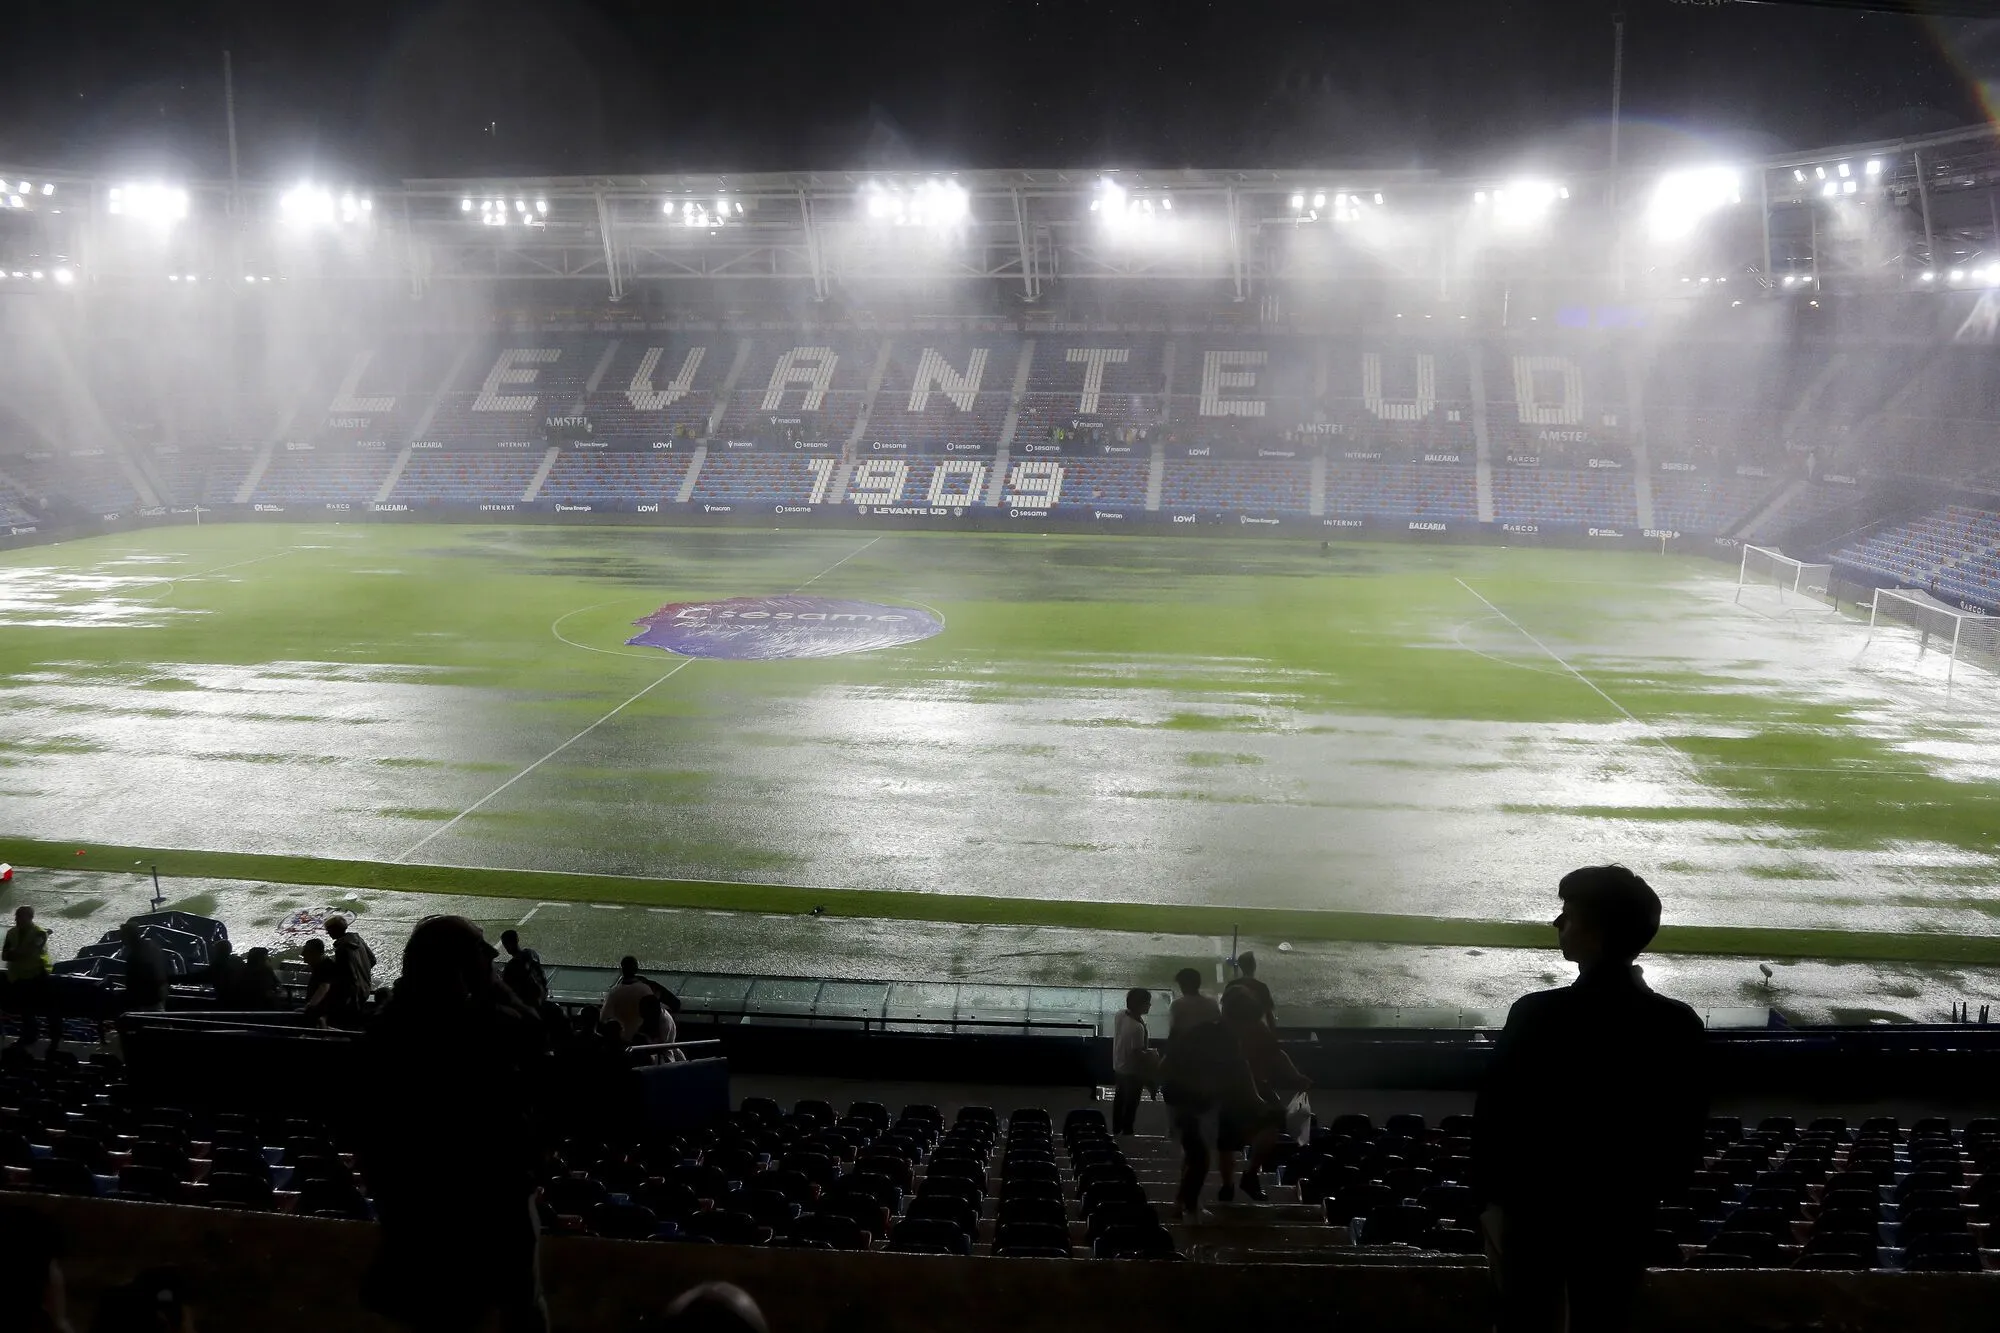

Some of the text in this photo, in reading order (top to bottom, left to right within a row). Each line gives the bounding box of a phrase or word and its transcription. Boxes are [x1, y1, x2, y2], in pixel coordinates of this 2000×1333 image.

[807, 458, 1064, 508] 1909
[873, 507, 948, 515] LEVANTE UD
[718, 609, 909, 623] sesame
